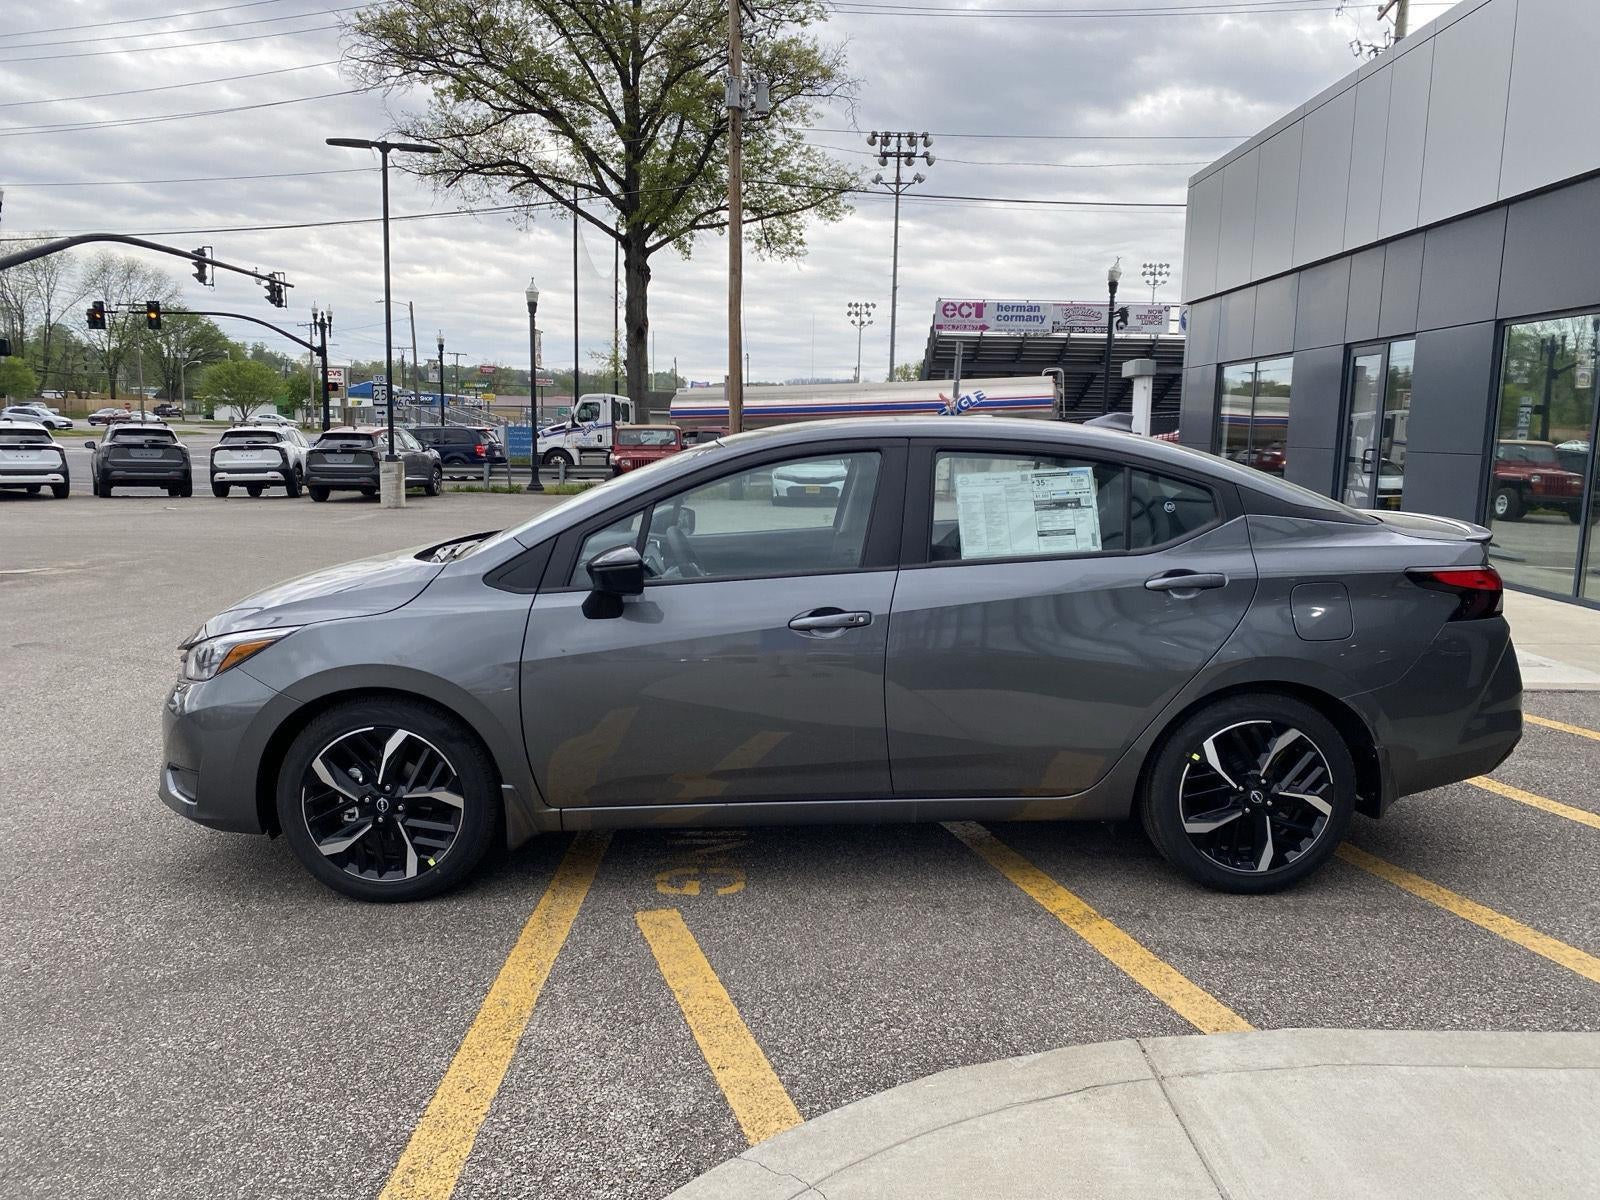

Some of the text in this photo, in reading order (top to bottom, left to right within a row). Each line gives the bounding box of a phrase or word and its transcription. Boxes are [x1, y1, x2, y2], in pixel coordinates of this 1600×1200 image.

[996, 303, 1041, 312] herman
[996, 314, 1047, 323] cormany
[374, 389, 387, 401] 25
[398, 399, 410, 407] 60
[1036, 479, 1046, 487] 35
